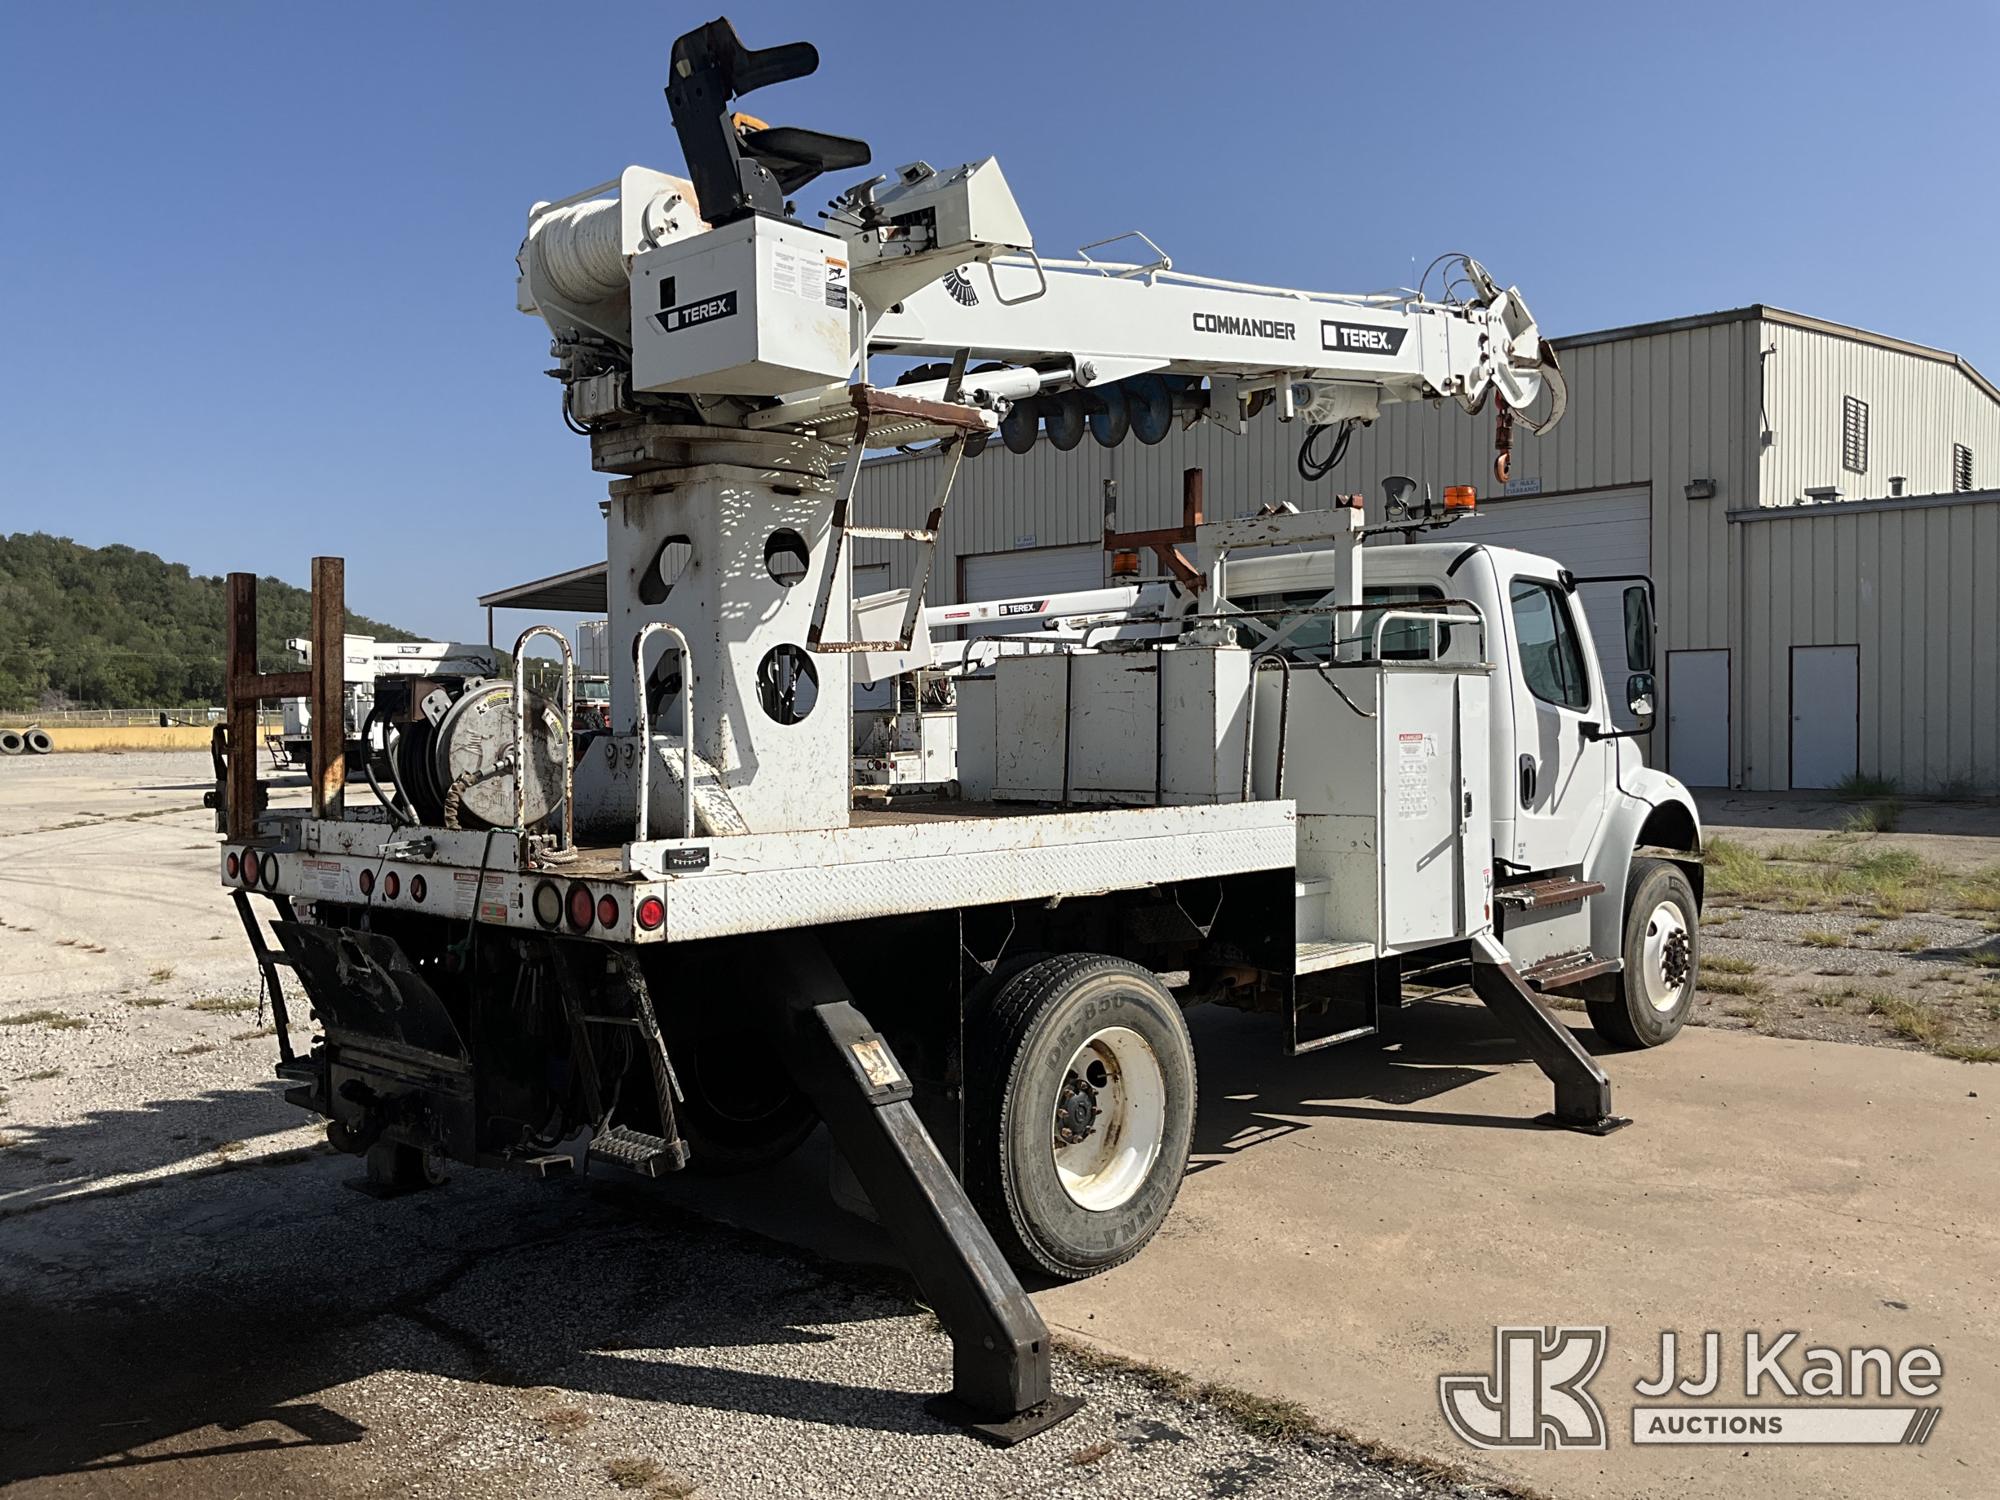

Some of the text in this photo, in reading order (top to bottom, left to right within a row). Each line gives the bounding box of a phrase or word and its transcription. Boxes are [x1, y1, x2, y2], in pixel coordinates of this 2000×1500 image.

[682, 298, 727, 323] TEREX
[1193, 312, 1295, 340] COMMANDER
[1340, 328, 1391, 349] TEREX
[1008, 603, 1034, 613] TEREX
